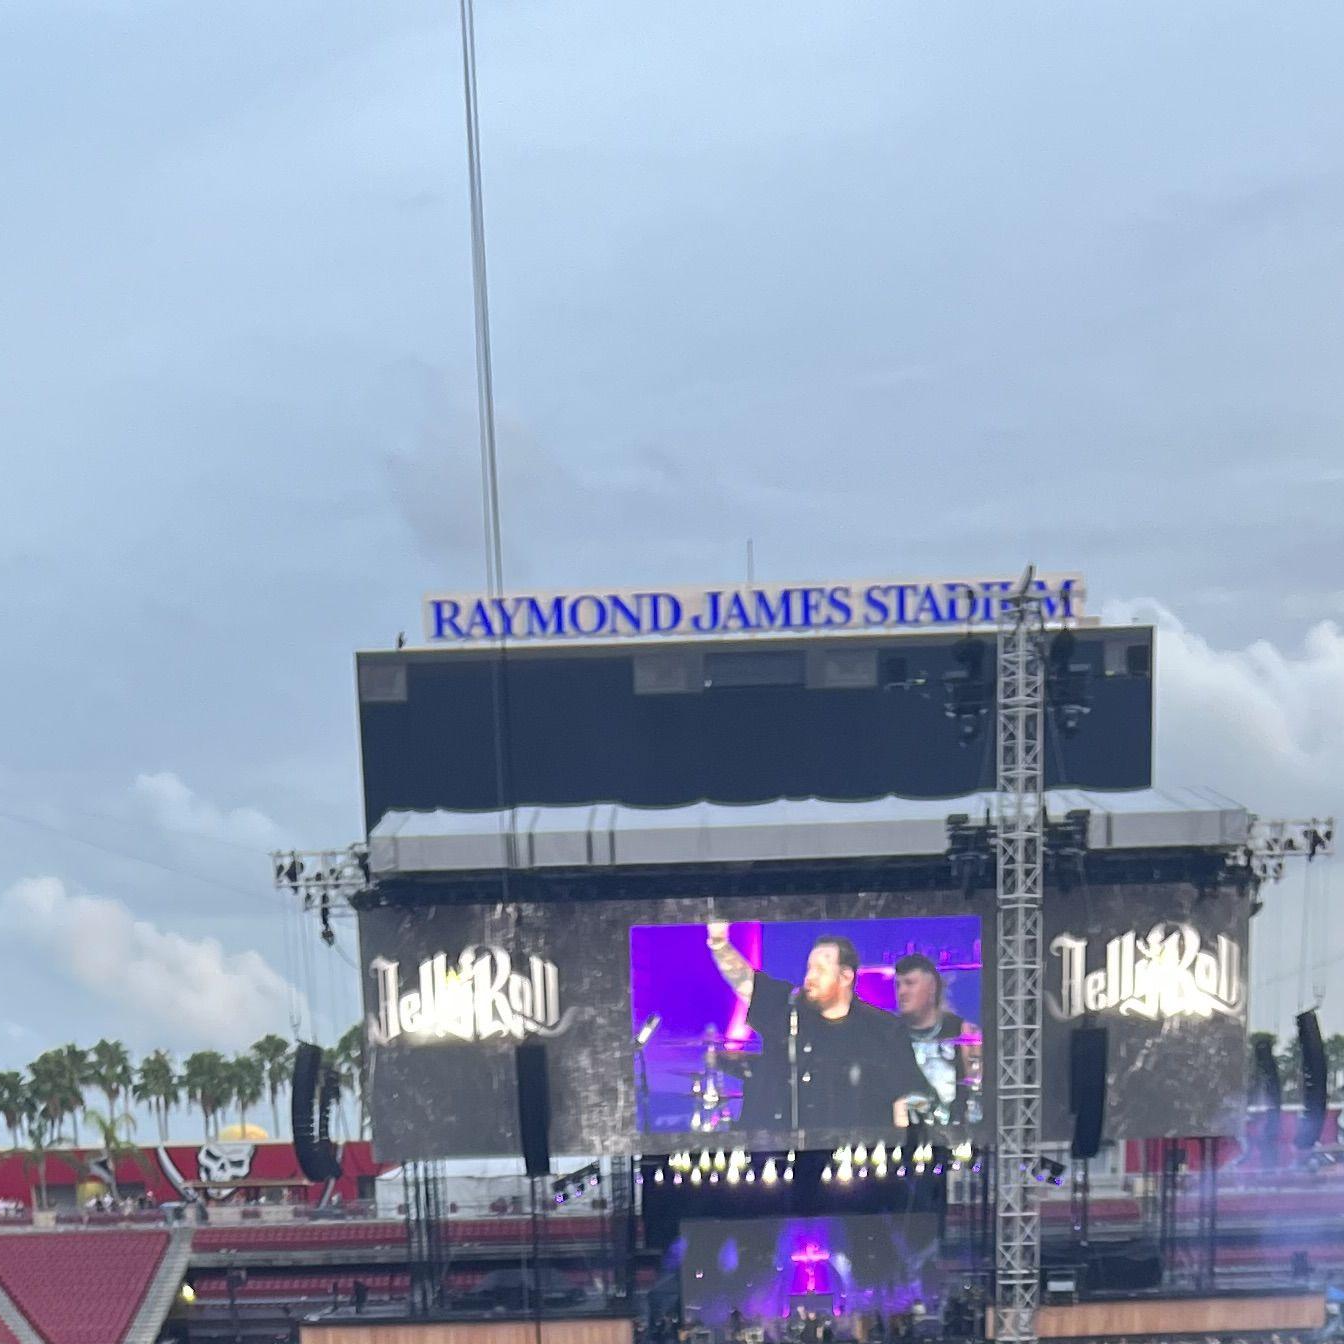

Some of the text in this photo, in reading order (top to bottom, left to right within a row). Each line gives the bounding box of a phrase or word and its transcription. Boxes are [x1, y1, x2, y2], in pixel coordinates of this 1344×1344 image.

[430, 591, 683, 640] RAYMOND
[690, 585, 854, 635] JAMES
[368, 944, 580, 1046] Jelly Roll
[1044, 920, 1246, 1022] Jelly Roll
